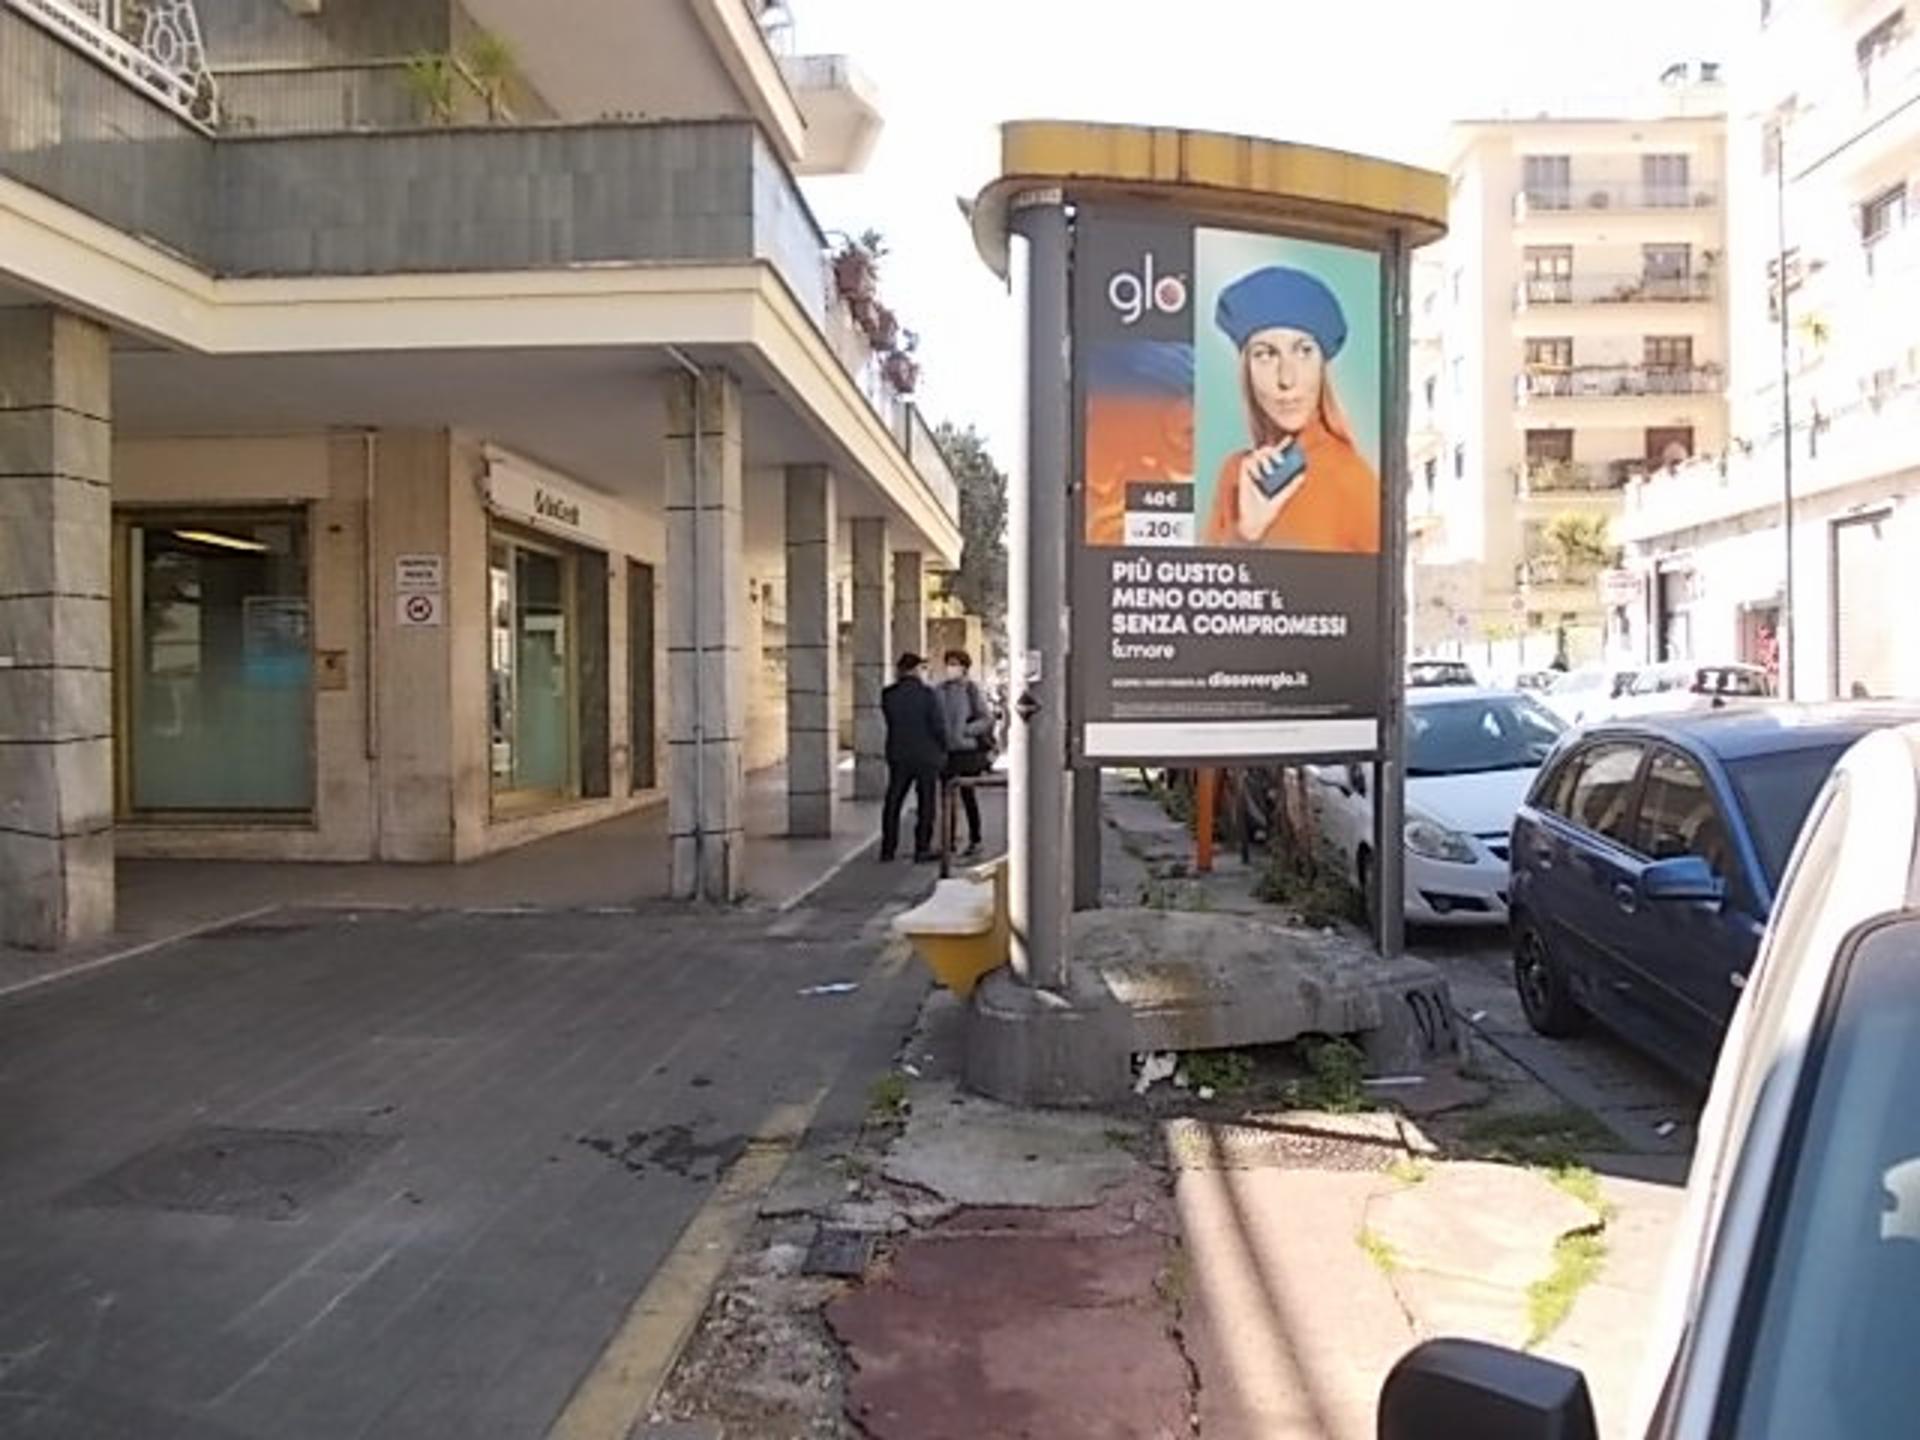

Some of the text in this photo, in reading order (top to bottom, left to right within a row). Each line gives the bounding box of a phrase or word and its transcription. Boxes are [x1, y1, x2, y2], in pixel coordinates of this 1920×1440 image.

[1109, 252, 1187, 324] glo
[1112, 557, 1151, 582] PIÙ
[1157, 563, 1235, 583] GUSTO
[1112, 588, 1183, 608] MENO
[1112, 614, 1347, 635] SENZA COMPROMESSI
